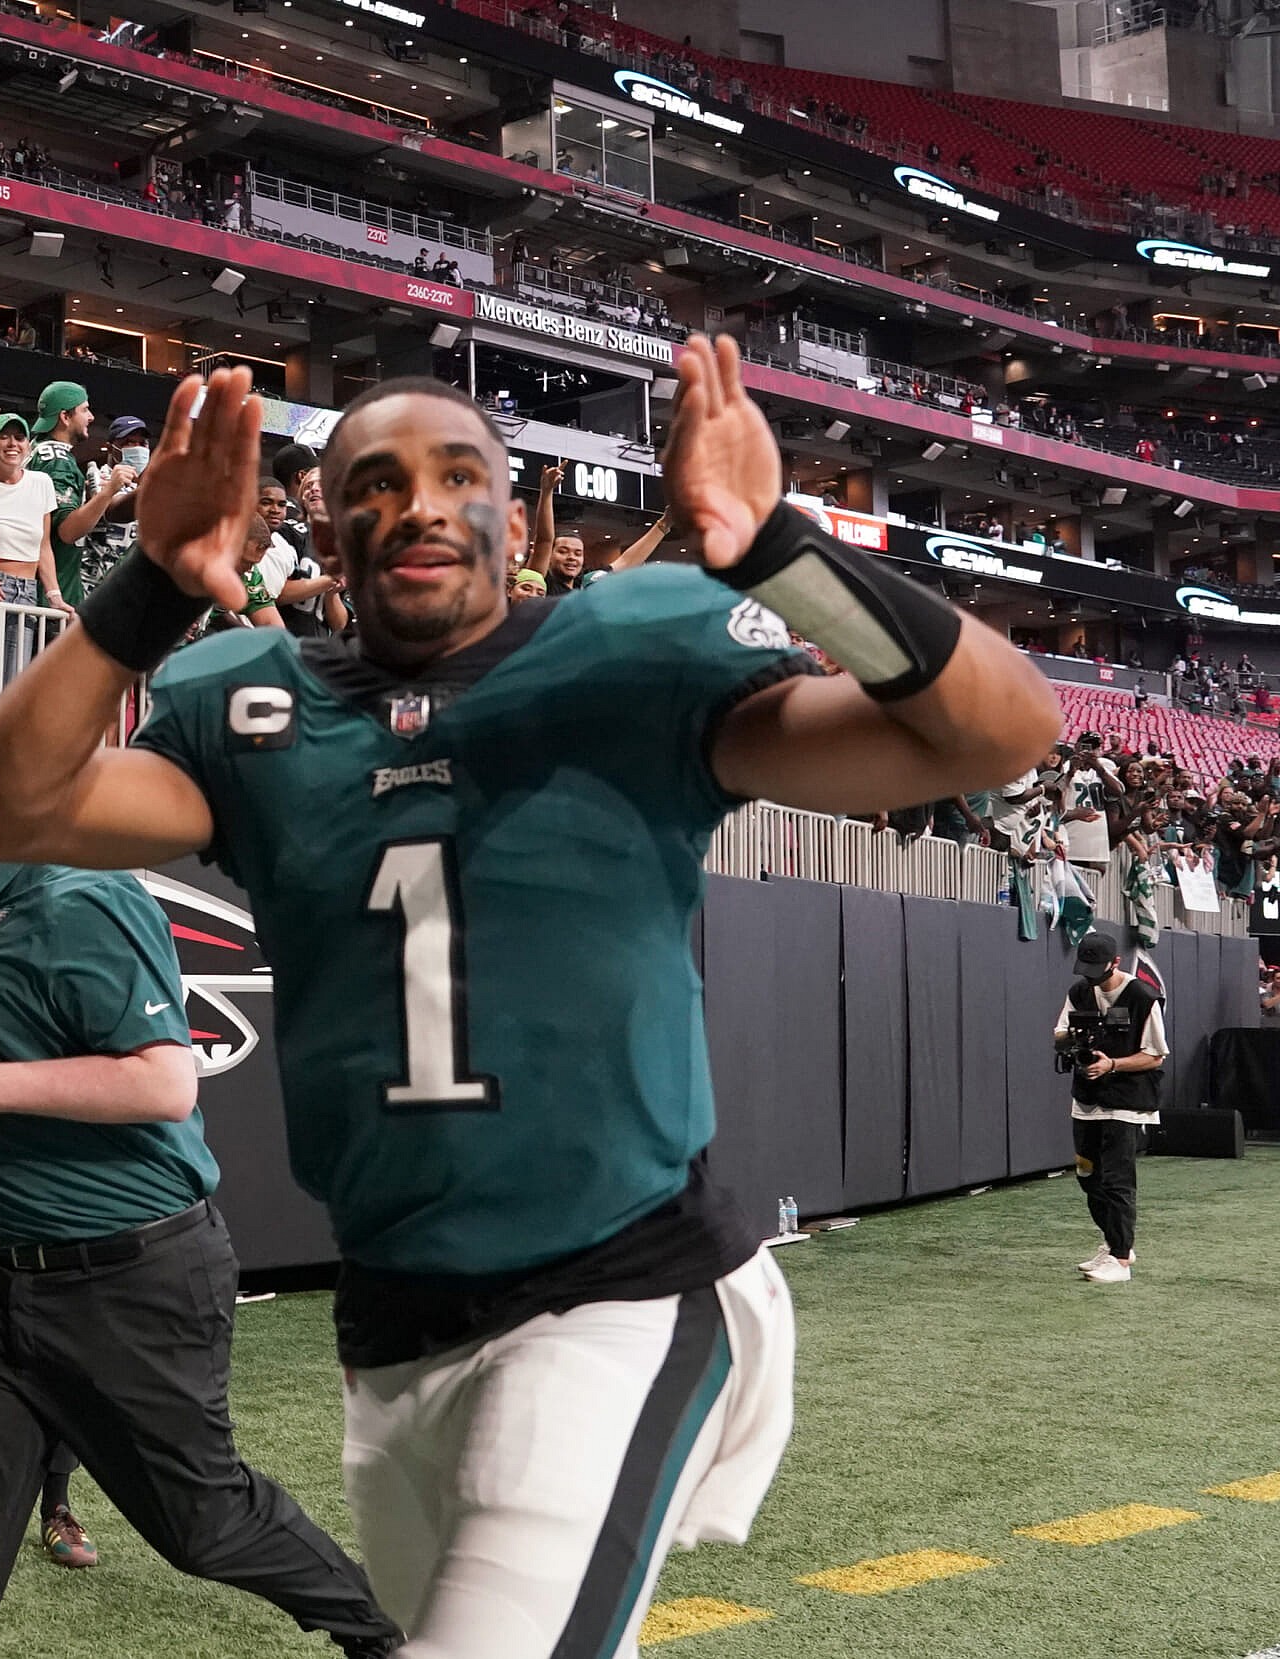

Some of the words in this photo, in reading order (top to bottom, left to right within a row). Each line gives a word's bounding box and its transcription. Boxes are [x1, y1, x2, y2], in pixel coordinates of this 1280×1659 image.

[366, 226, 388, 244] 237C
[406, 283, 454, 307] 236C-237C
[478, 293, 604, 346] Mercedes-Benz
[607, 328, 673, 363] Stadium
[575, 463, 618, 502] 0:00
[228, 686, 294, 736] C
[372, 758, 453, 798] EAGLES
[1074, 782, 1105, 812] 20
[366, 837, 498, 1111] 1
